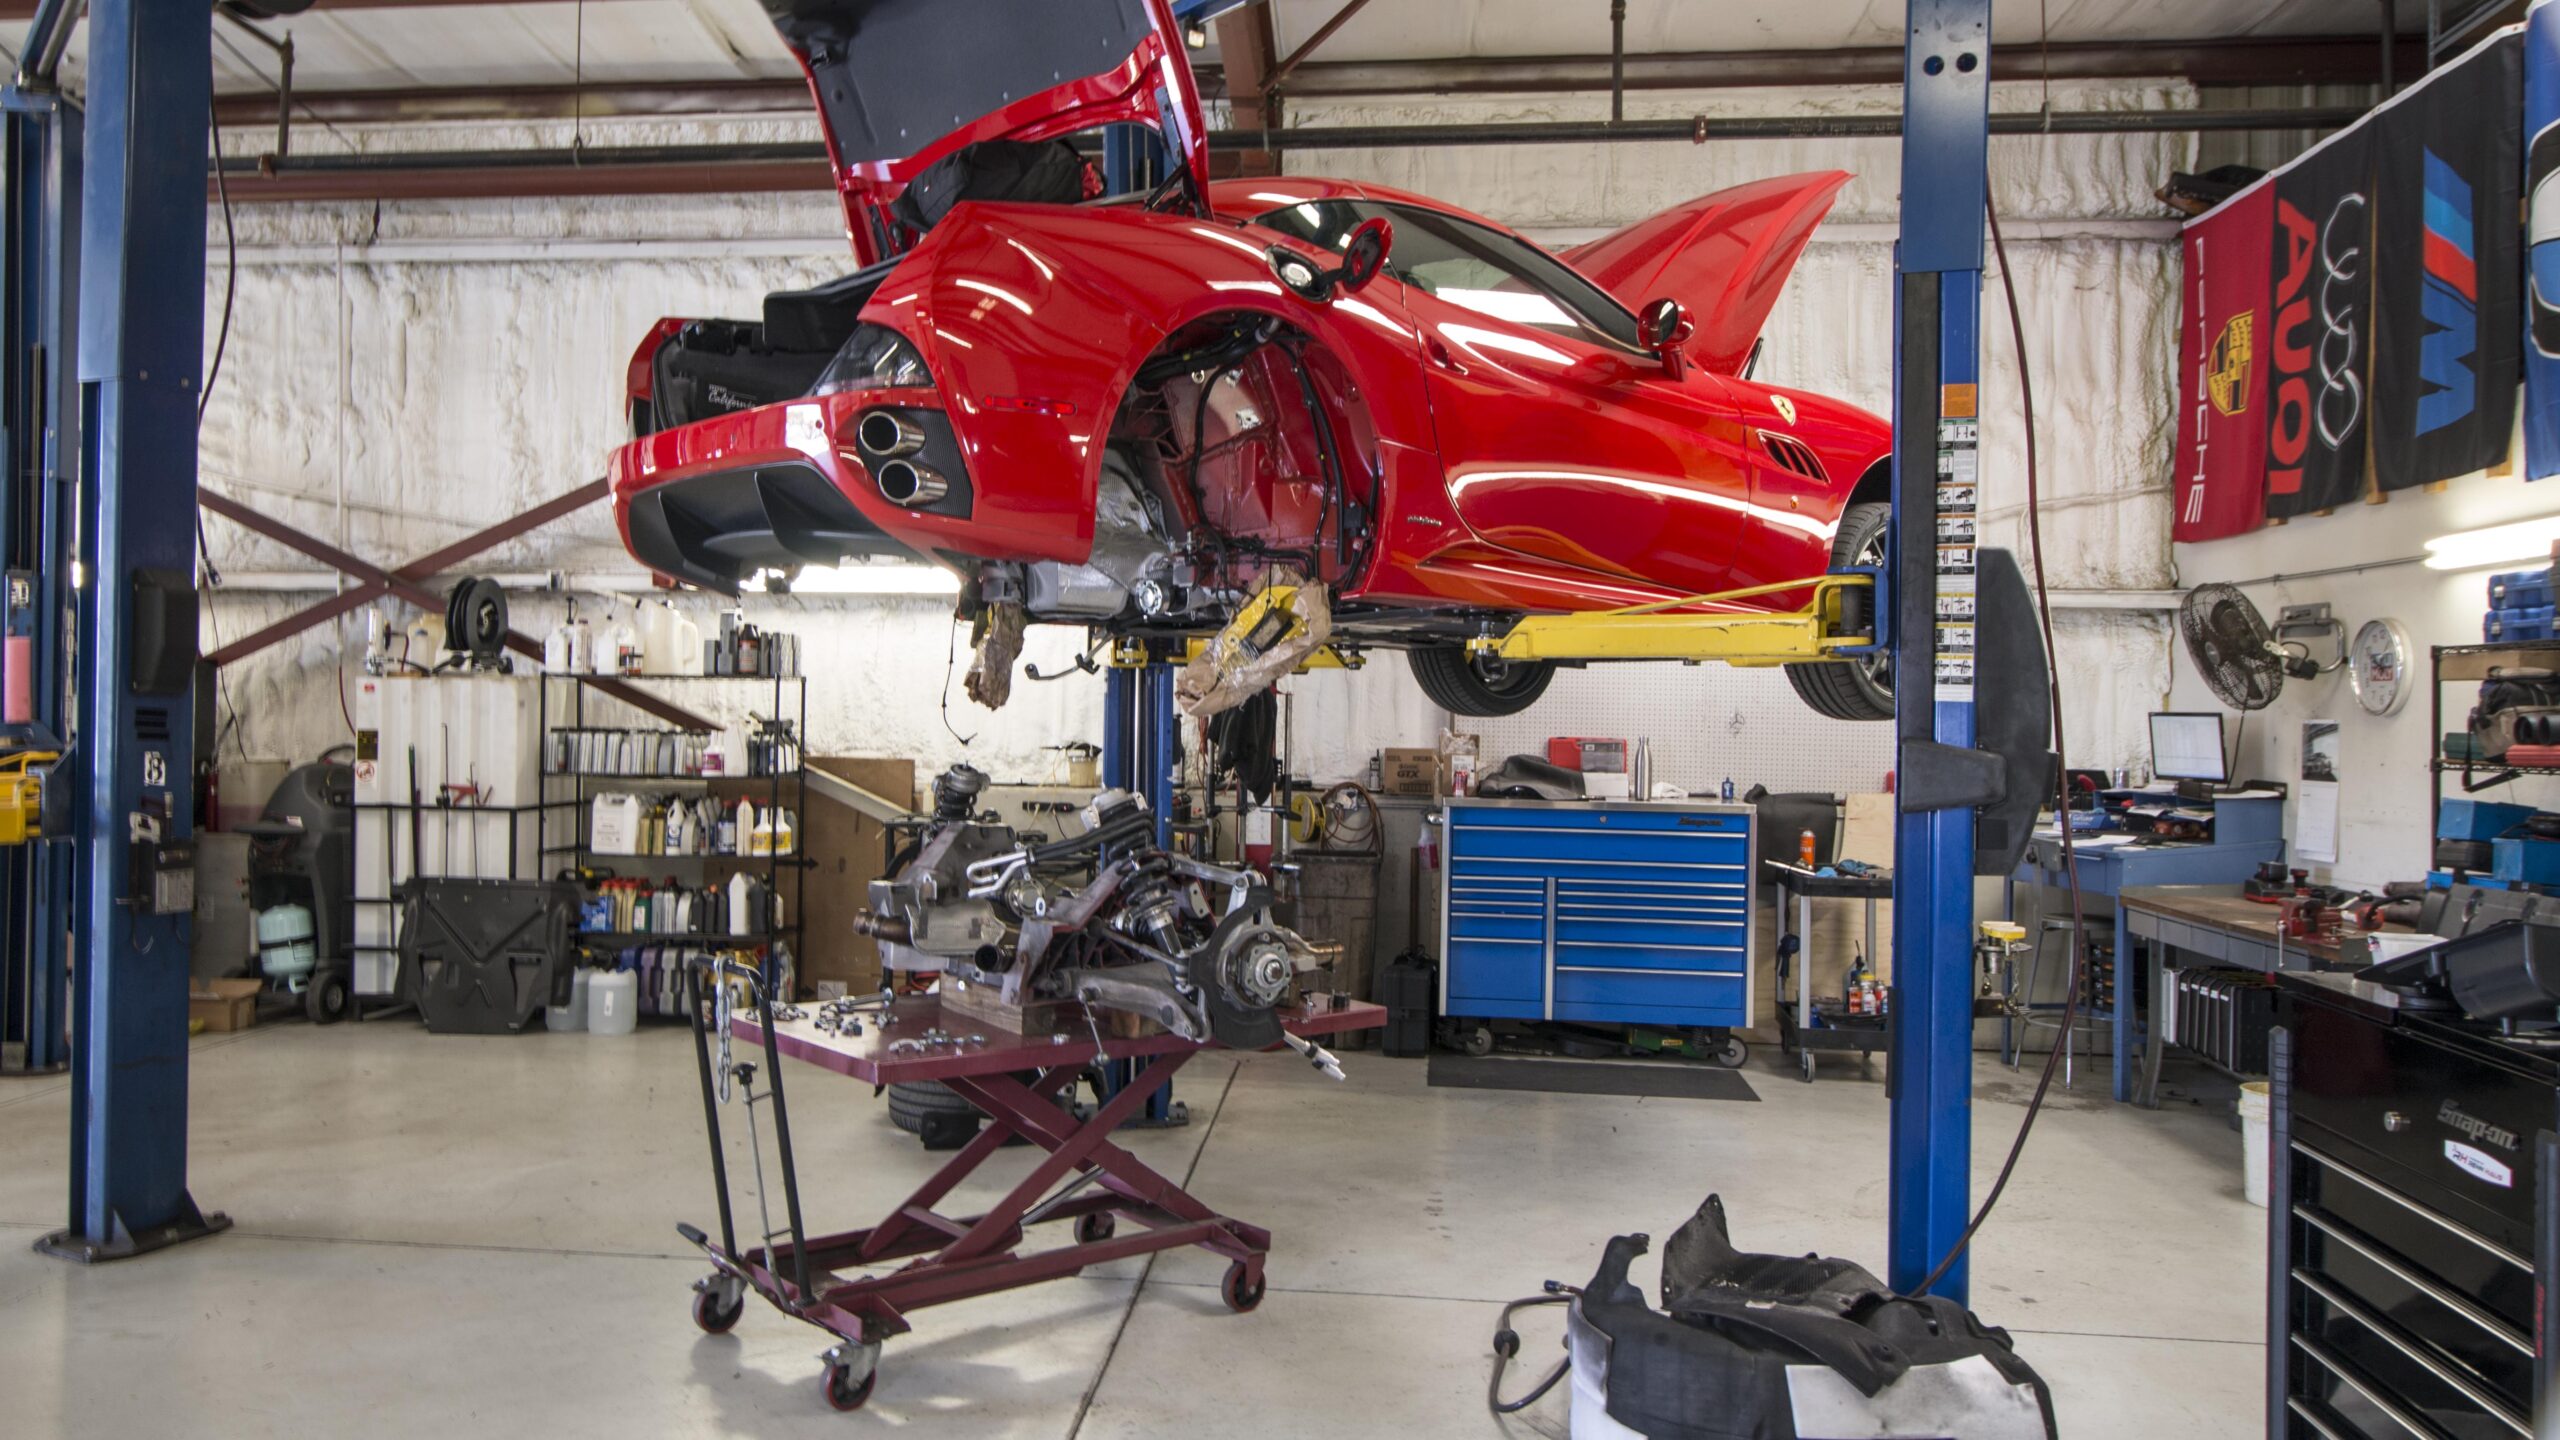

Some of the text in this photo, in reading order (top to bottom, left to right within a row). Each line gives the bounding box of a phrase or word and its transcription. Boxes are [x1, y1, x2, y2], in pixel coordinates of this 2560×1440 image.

[2184, 237, 2208, 523] PORSCHE
[2269, 197, 2317, 495] AUDI
[1397, 769, 1420, 778] GTX
[2437, 1098, 2517, 1151] Snap-on
